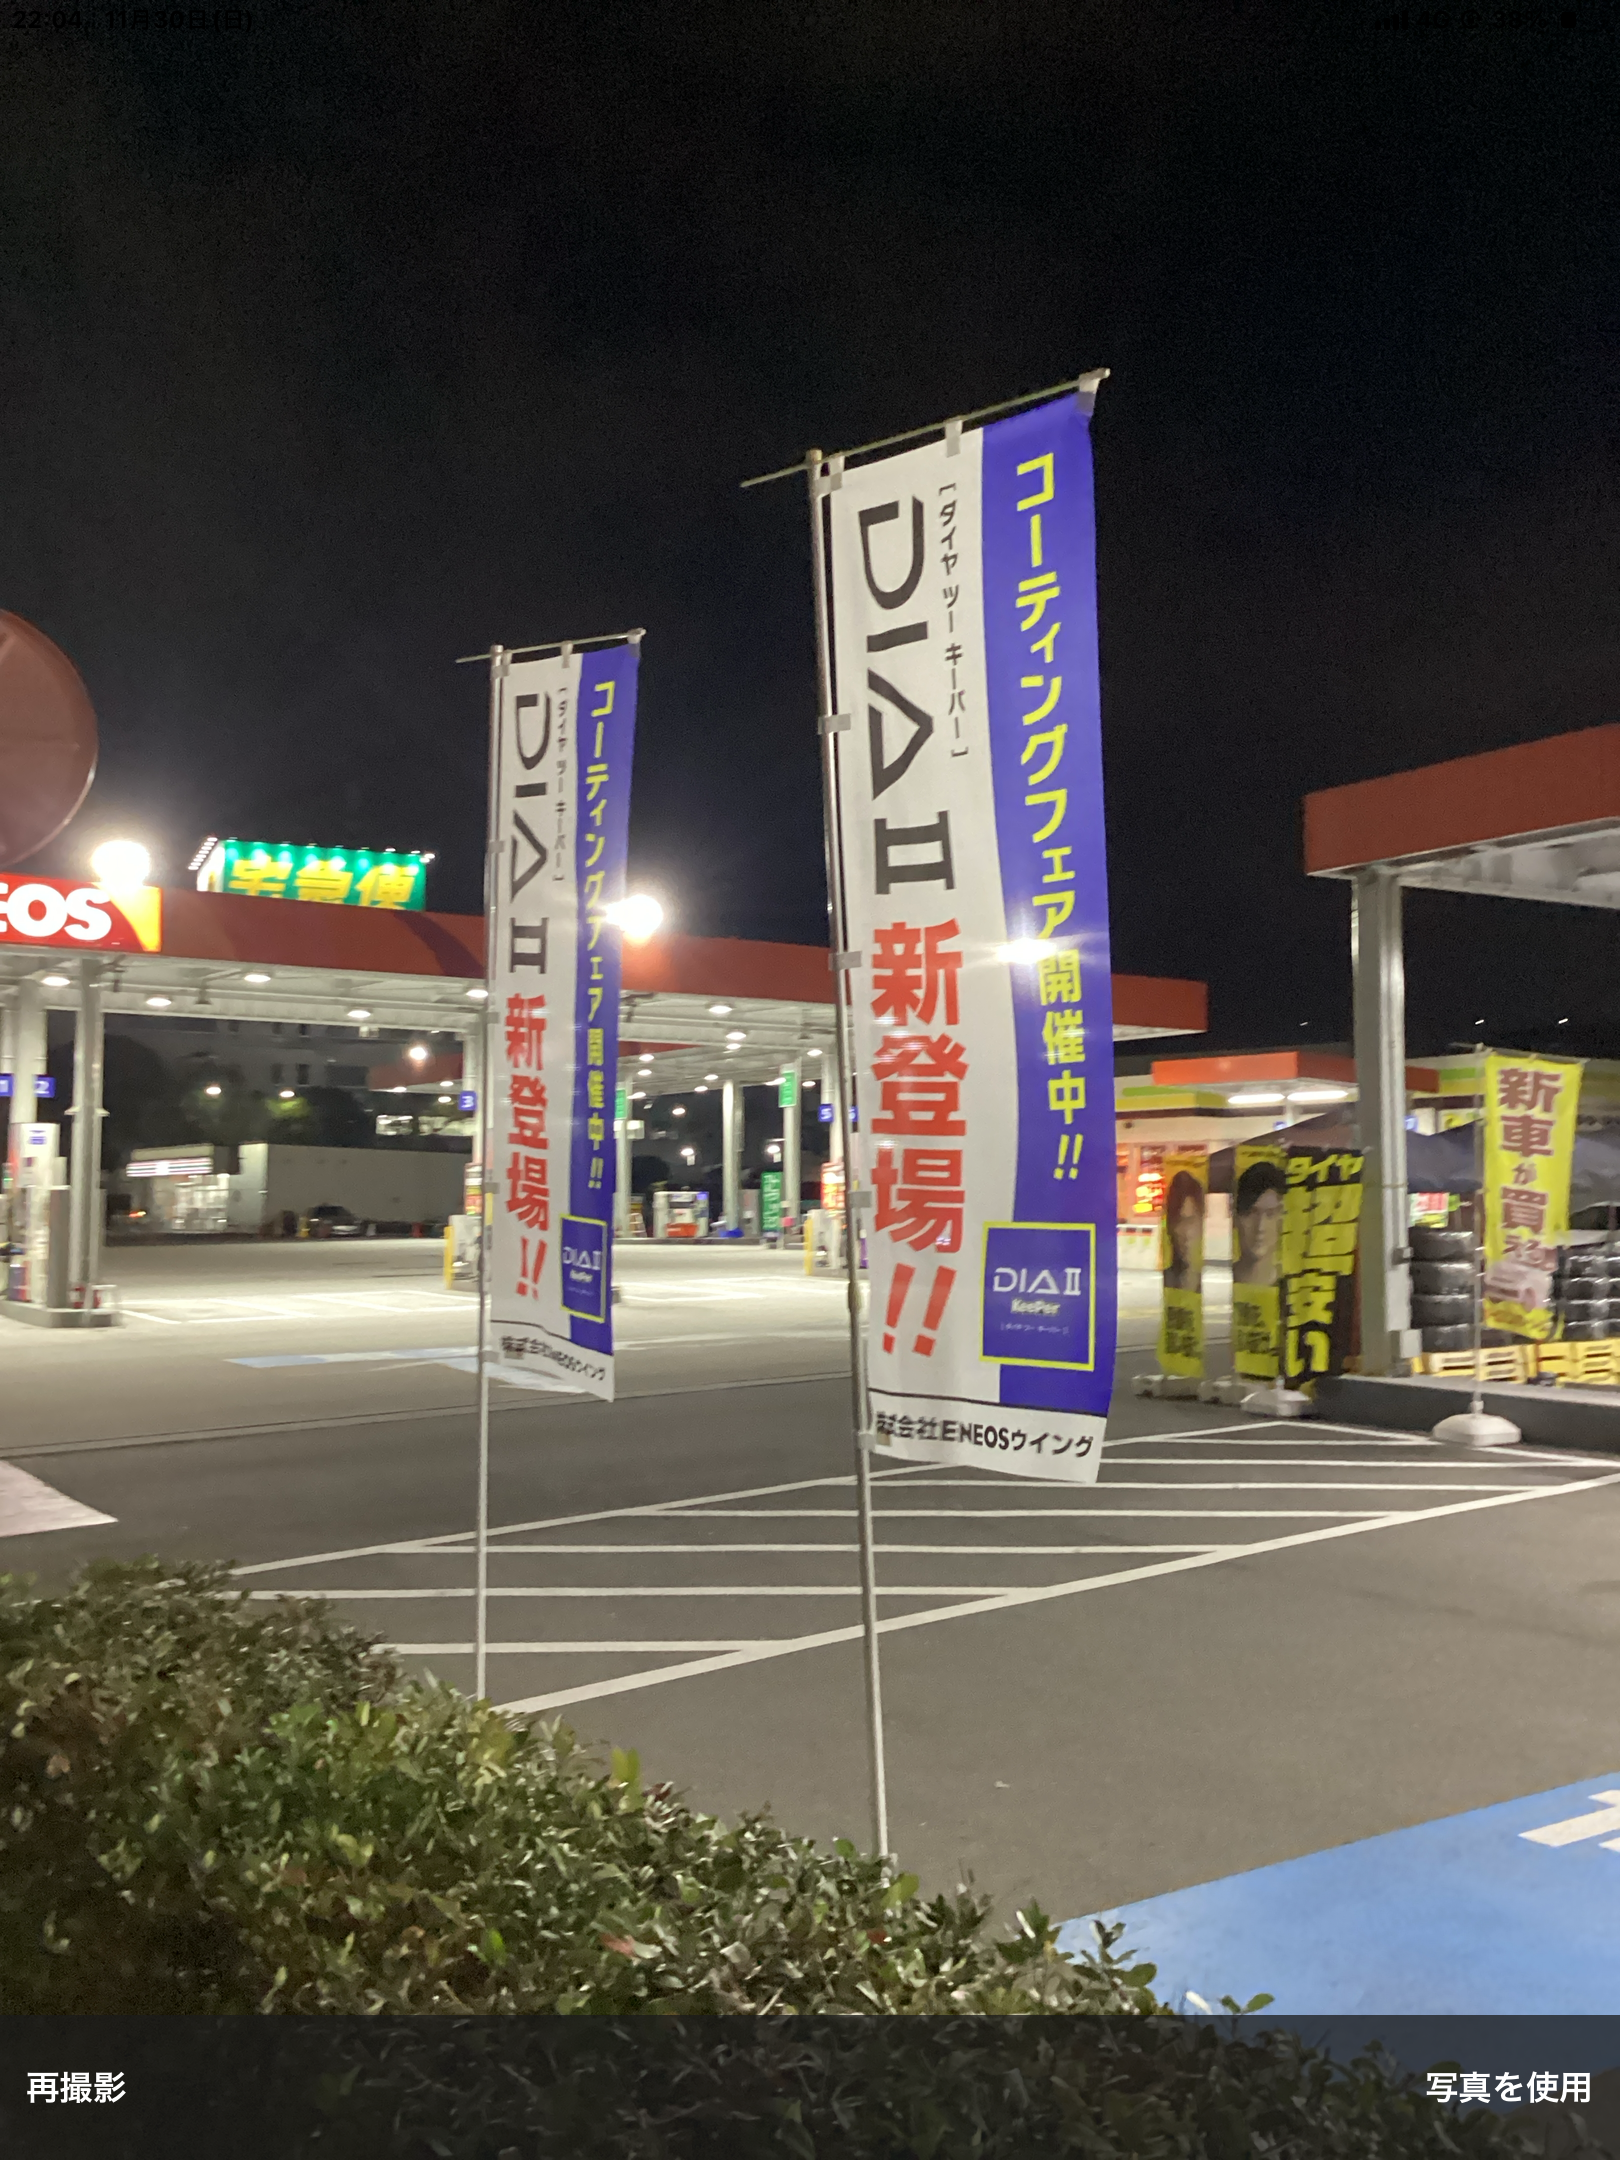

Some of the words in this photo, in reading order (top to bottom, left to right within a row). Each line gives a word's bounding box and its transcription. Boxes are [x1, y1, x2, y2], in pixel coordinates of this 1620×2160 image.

[227, 854, 417, 911] 宅急便
[0, 882, 112, 942] OS
[33, 1080, 50, 1095] 2
[460, 1095, 475, 1109] 3
[820, 1107, 833, 1120] 5
